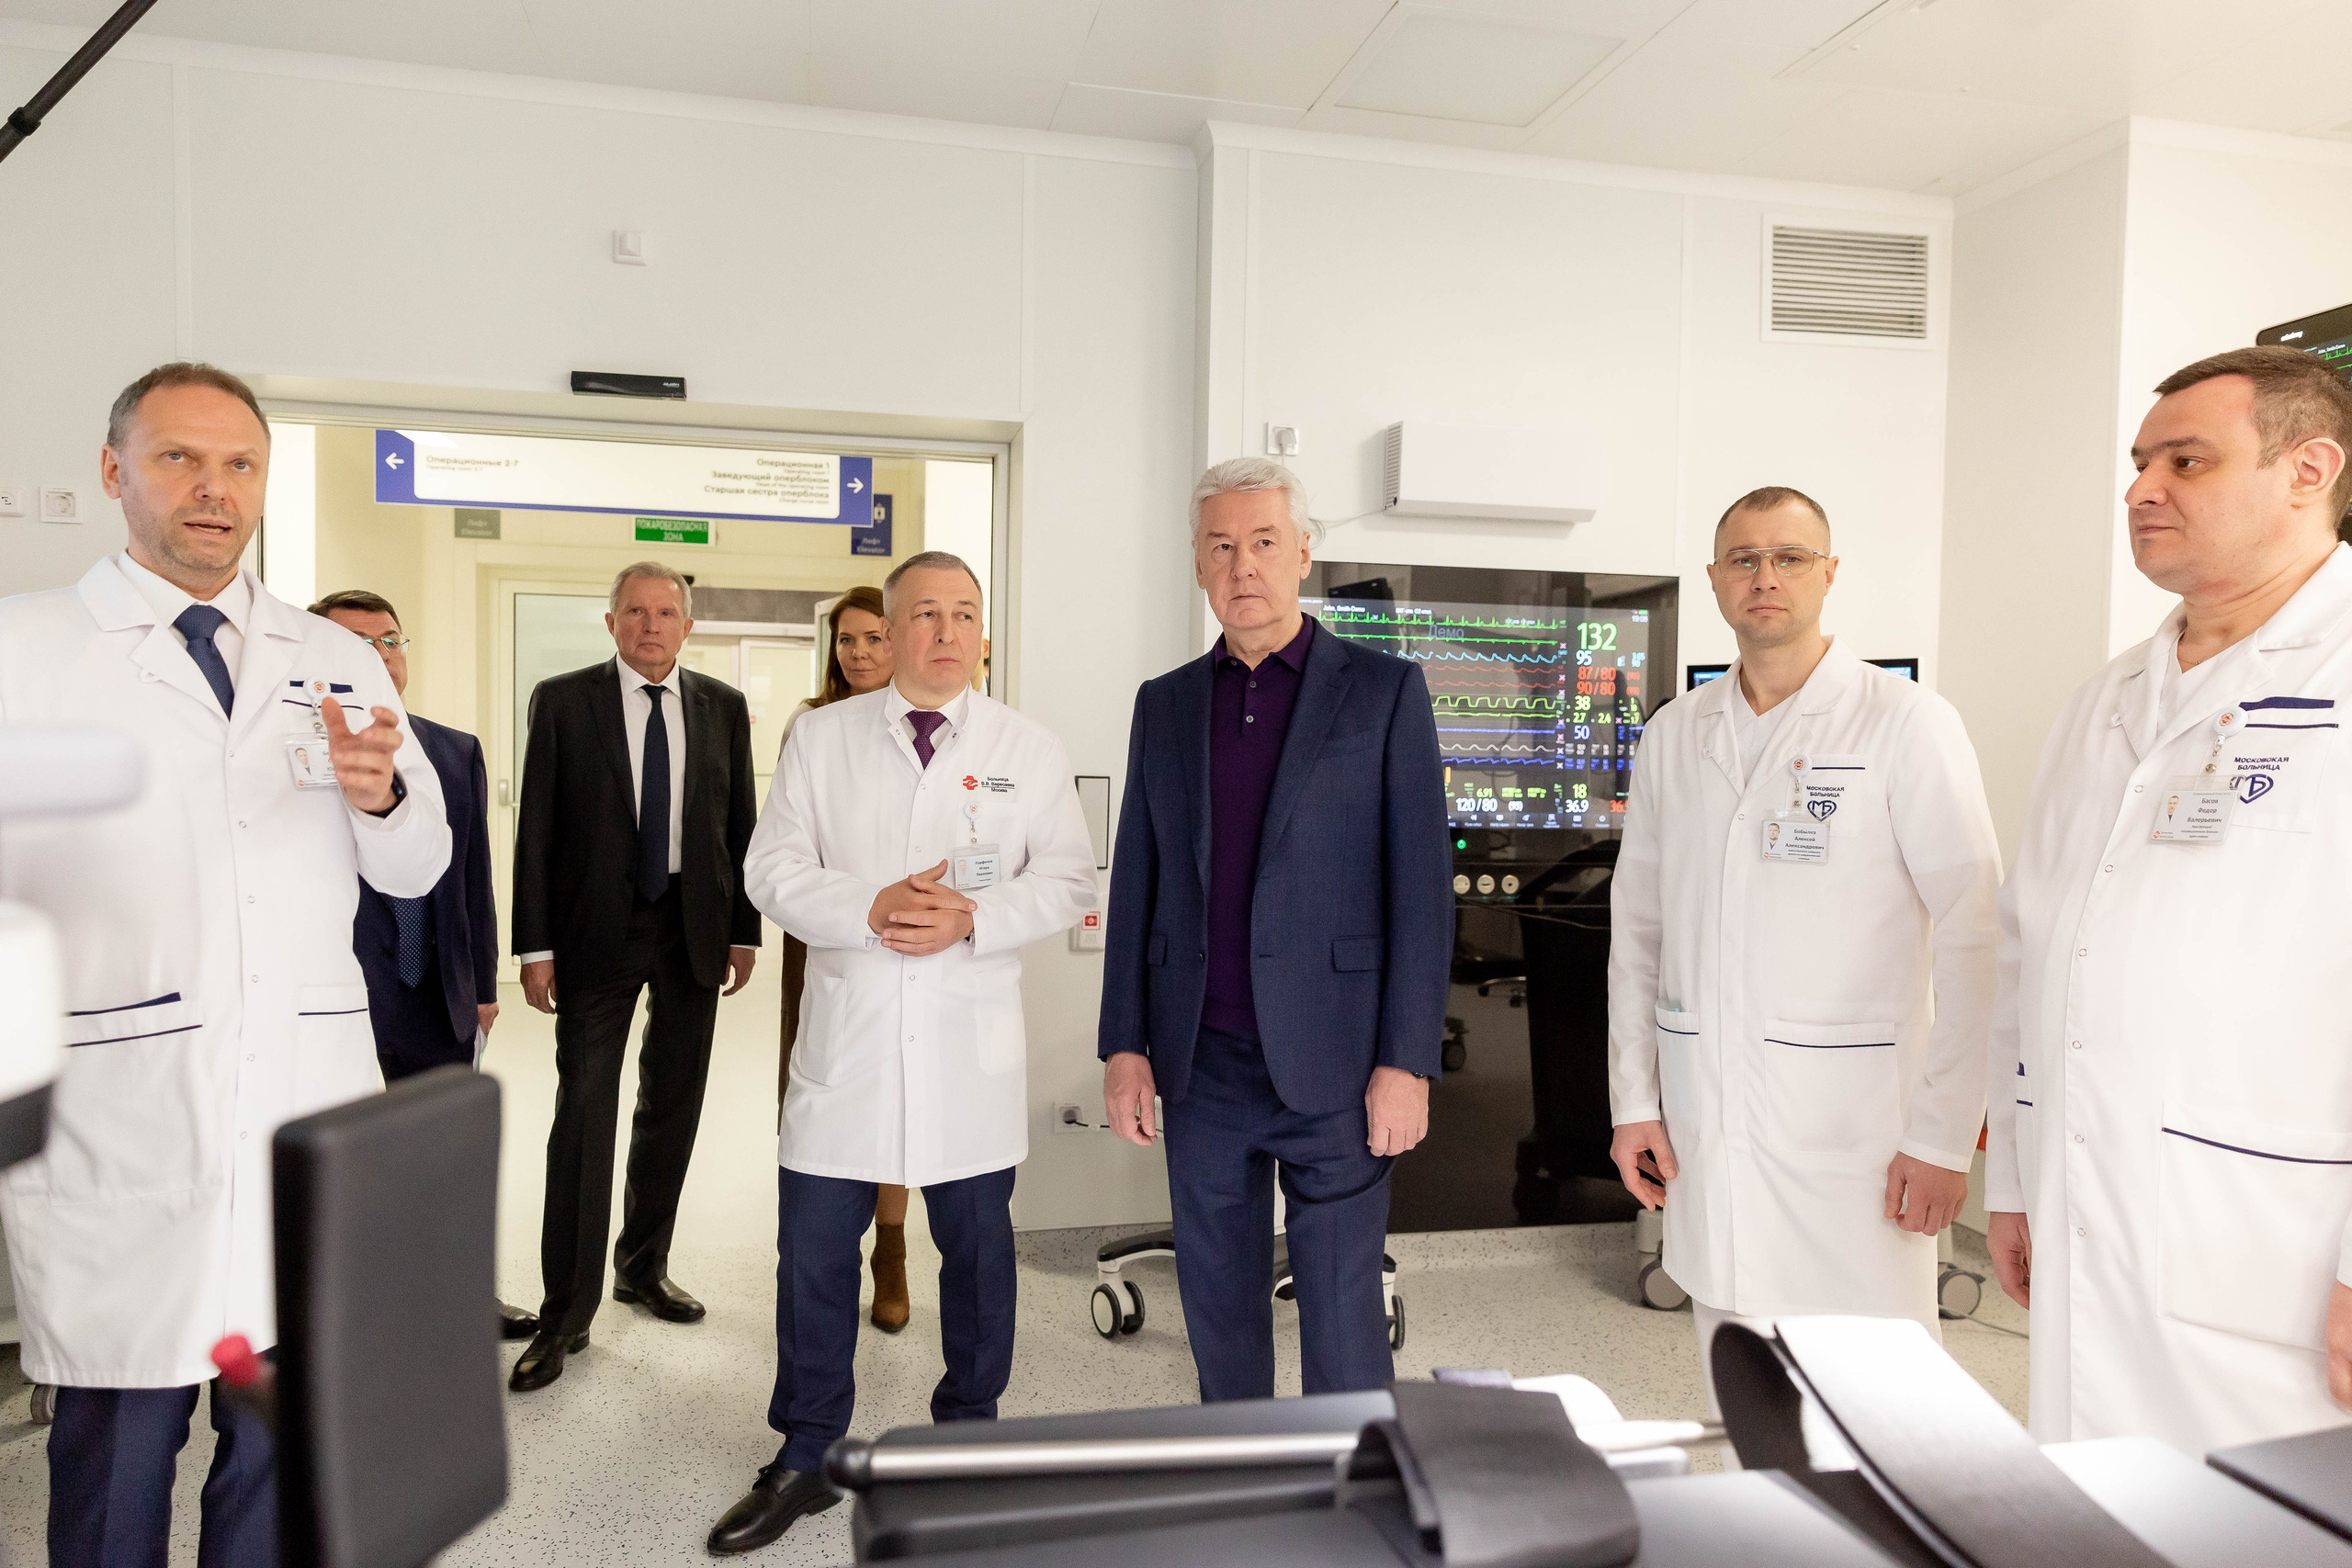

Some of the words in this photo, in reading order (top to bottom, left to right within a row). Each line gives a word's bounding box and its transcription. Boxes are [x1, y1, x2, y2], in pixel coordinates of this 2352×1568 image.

[426, 455, 502, 466] Операционные
[756, 458, 824, 468] Операционная
[712, 470, 772, 481] Заведующий
[774, 474, 830, 483] оперблоком
[704, 485, 745, 494] Старшая
[781, 490, 830, 498] оперблока
[663, 531, 684, 542] ЗОНА
[1428, 625, 1465, 639] Демо
[1577, 622, 1617, 651] 132
[1576, 649, 1593, 666] 95
[1574, 695, 1591, 711] 38
[1573, 725, 1590, 740] 50
[1572, 784, 1588, 799] 18
[1455, 797, 1498, 812] 120/80
[1565, 799, 1589, 813] 36.9
